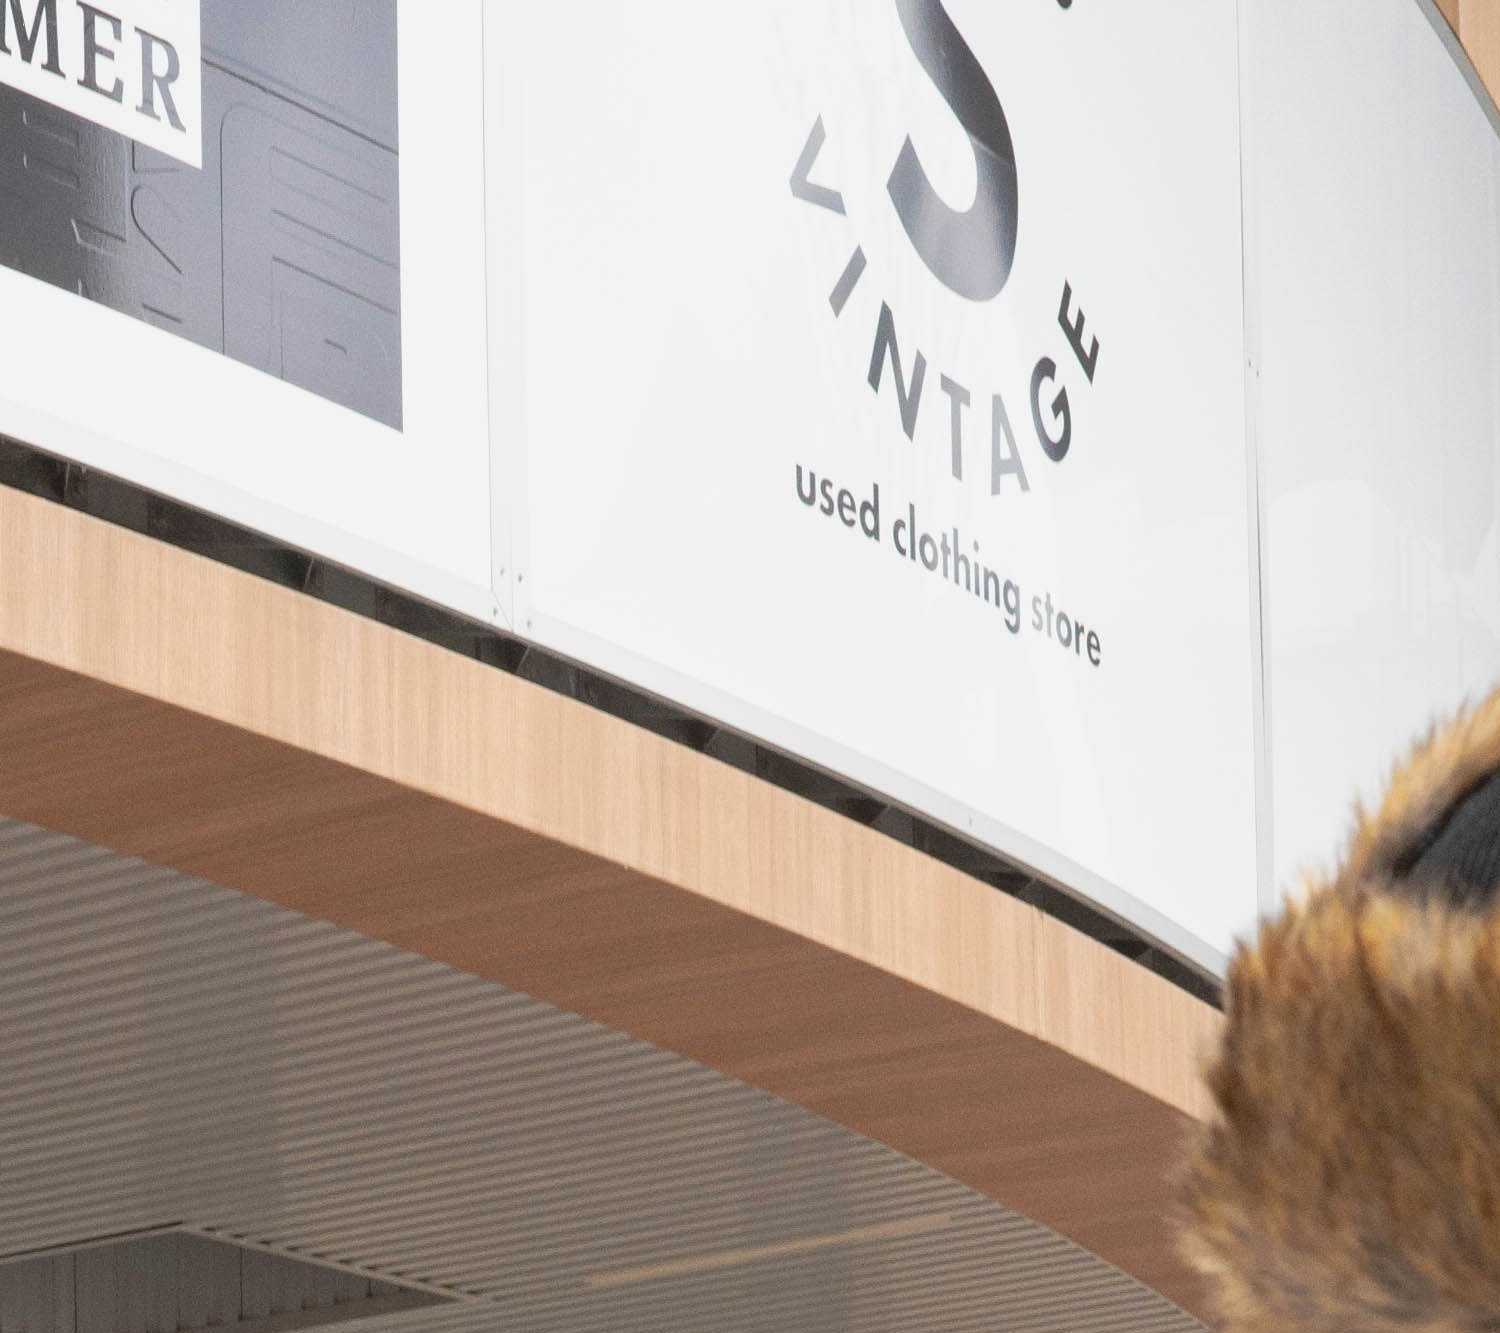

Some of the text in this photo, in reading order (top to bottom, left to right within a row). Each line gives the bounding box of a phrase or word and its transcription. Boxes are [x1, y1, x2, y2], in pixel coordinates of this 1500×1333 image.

[789, 112, 1100, 496] VINTAGE
[795, 463, 1101, 667] used clothing store
